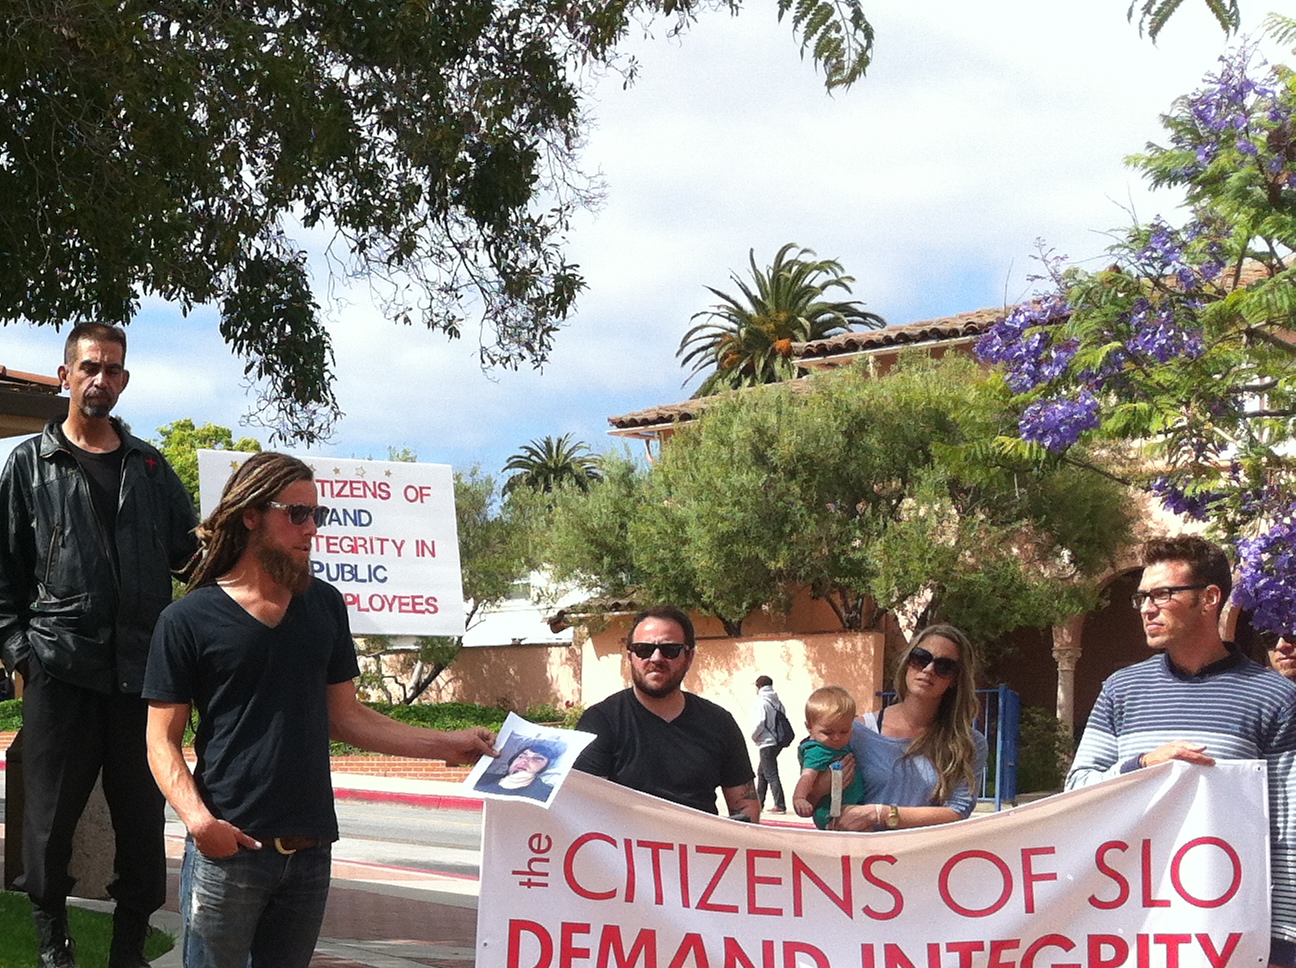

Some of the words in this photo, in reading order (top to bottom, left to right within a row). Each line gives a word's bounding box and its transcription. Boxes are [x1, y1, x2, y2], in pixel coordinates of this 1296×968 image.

[315, 479, 391, 501] TIZENS
[404, 485, 432, 504] OF
[323, 507, 373, 528] AND
[312, 534, 406, 557] TEGRITY
[415, 539, 436, 558] IN
[309, 560, 389, 584] PUBLIC
[344, 592, 439, 615] PLOYEES
[512, 832, 553, 889] the
[563, 832, 905, 921] CITIZENS
[938, 846, 1058, 919] OF
[1088, 836, 1243, 911] SLO
